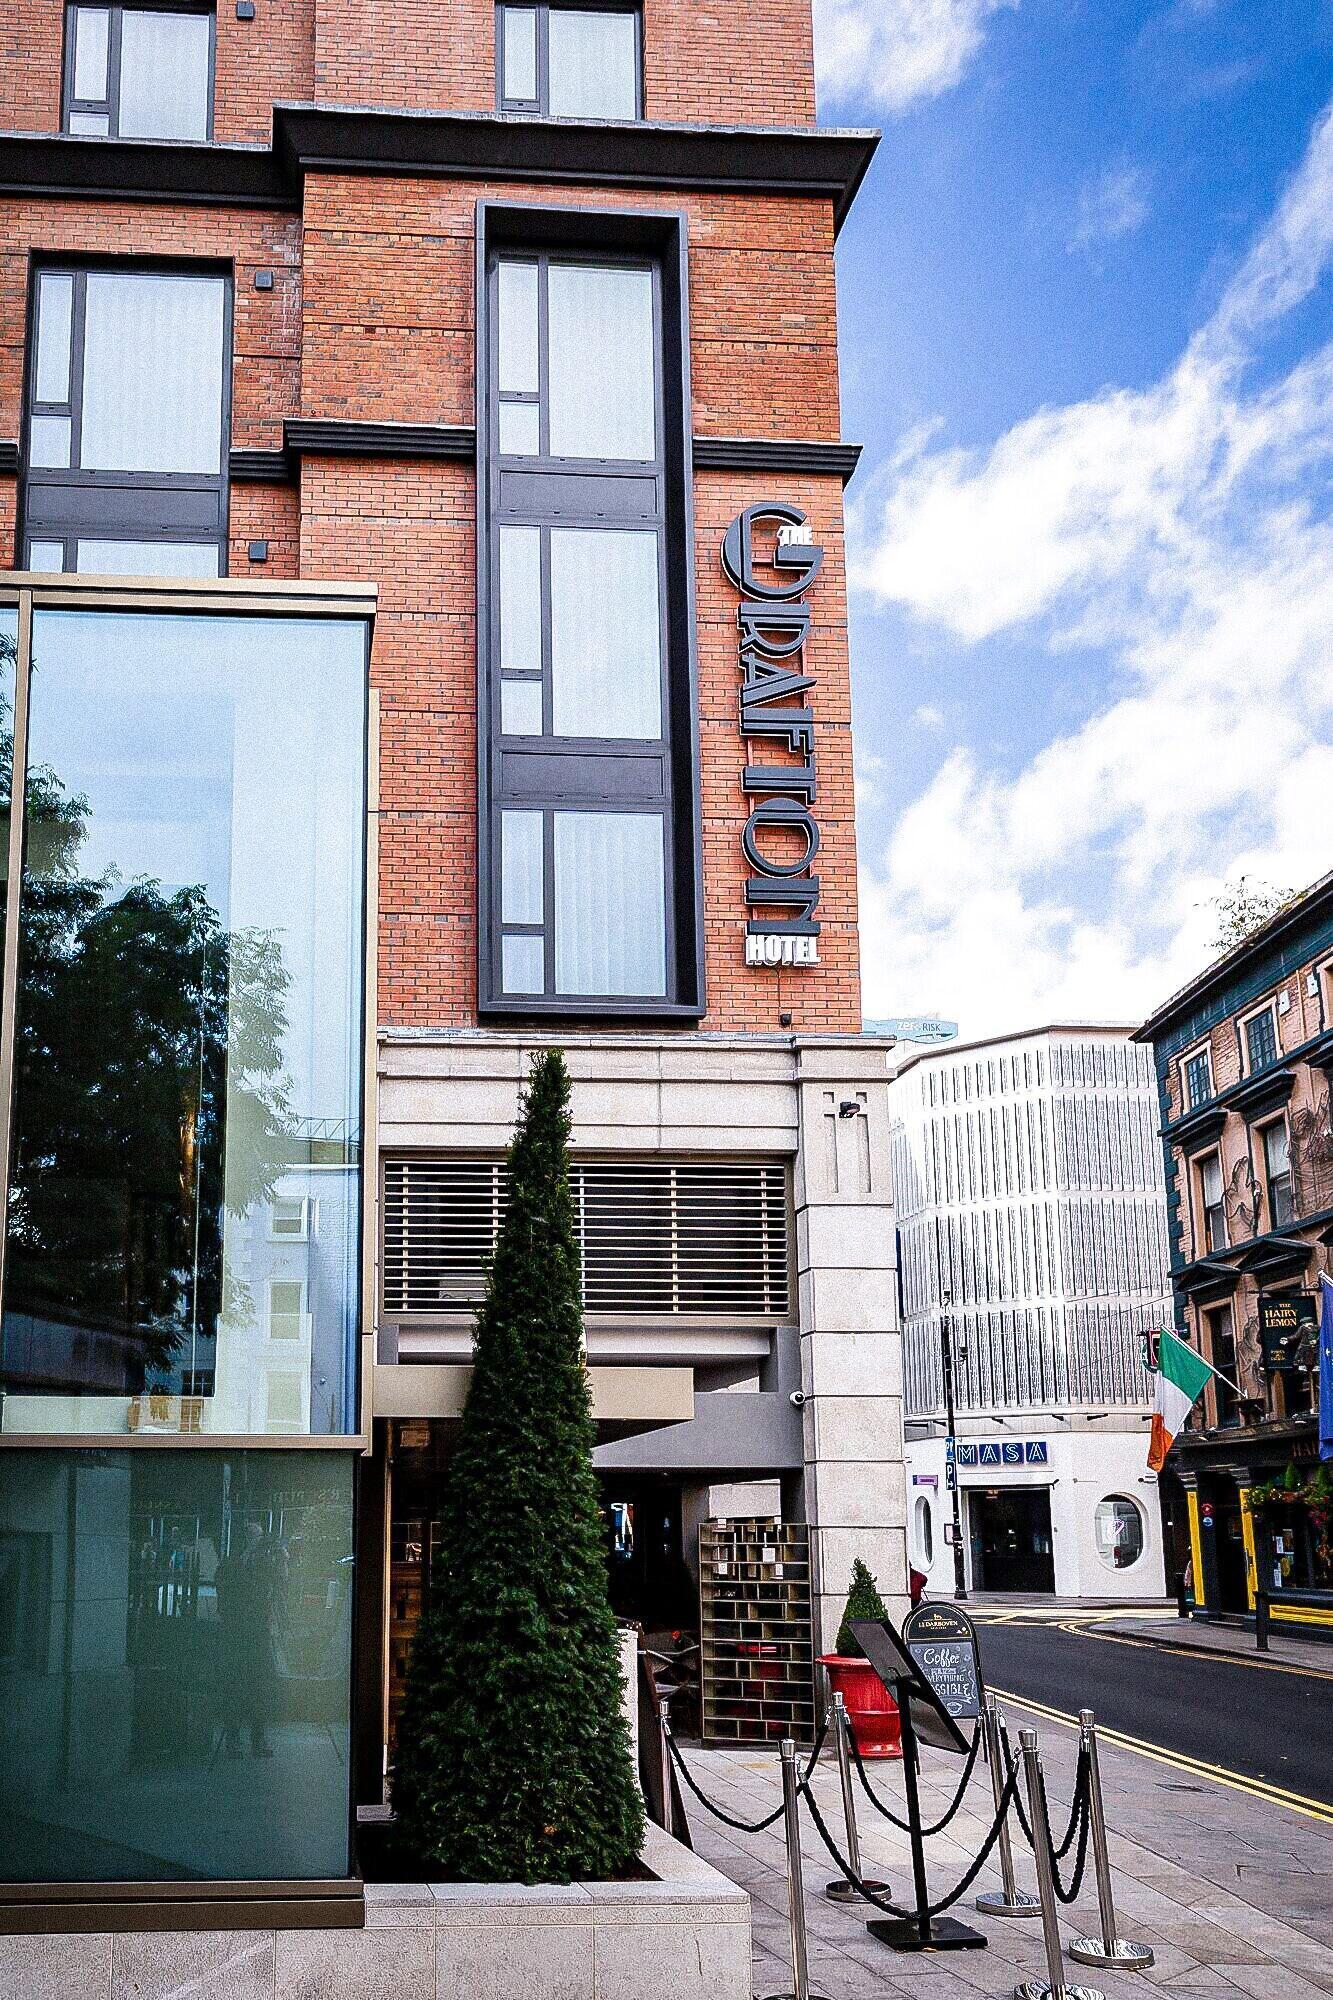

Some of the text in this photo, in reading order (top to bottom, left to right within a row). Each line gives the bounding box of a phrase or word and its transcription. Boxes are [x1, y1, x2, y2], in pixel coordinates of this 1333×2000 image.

[777, 526, 813, 546] THE
[721, 502, 824, 935] GRAFTON
[746, 935, 821, 966] HOTEL
[922, 1022, 941, 1032] RISK
[1264, 1309, 1298, 1319] HAIRY
[1265, 1318, 1297, 1328] LEMON
[957, 1441, 1047, 1464] MASA
[923, 1648, 960, 1668] Coffee
[927, 1674, 965, 1683] VERYTHING
[934, 1683, 970, 1697] SSIBLE
